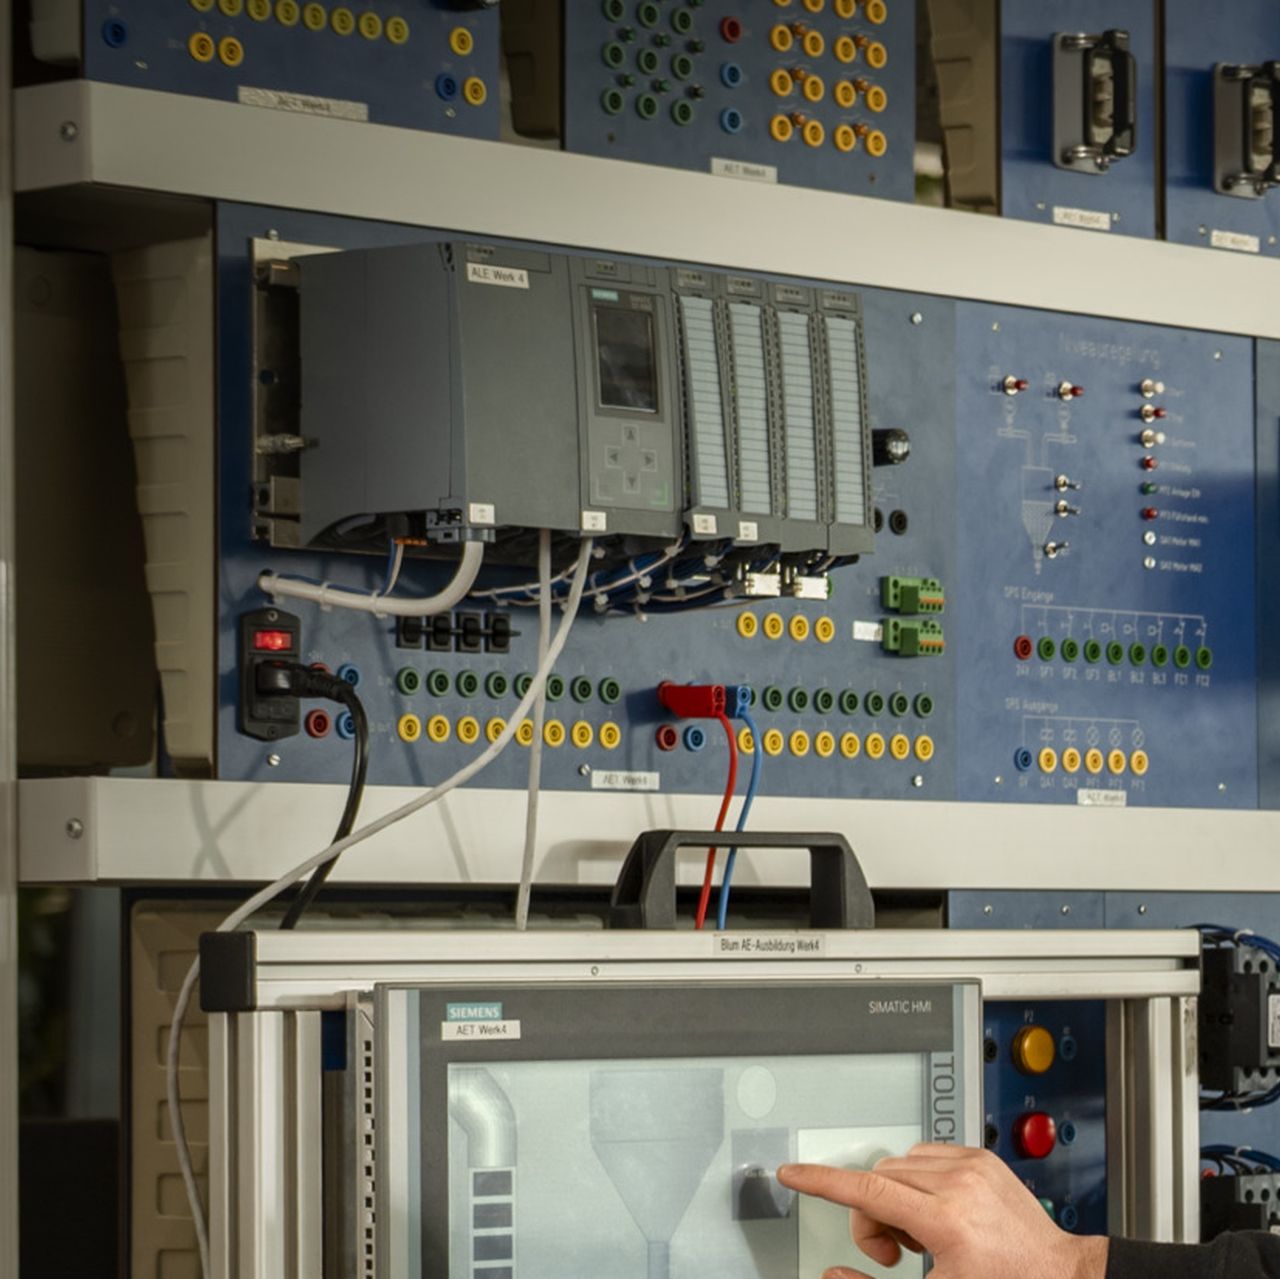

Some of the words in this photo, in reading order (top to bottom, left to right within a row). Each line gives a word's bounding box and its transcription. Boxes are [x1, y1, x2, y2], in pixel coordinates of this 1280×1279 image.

[494, 270, 514, 282] Werk
[518, 273, 525, 283] 4
[721, 938, 739, 951] Blum
[741, 938, 795, 953] AE-Ausbildung
[797, 939, 820, 951] Werk4
[449, 1007, 500, 1018] SIEMENS
[868, 1000, 910, 1014] SIMATIC
[912, 1000, 932, 1013] HMI
[456, 1024, 475, 1036] AET
[479, 1024, 507, 1036] Werk4
